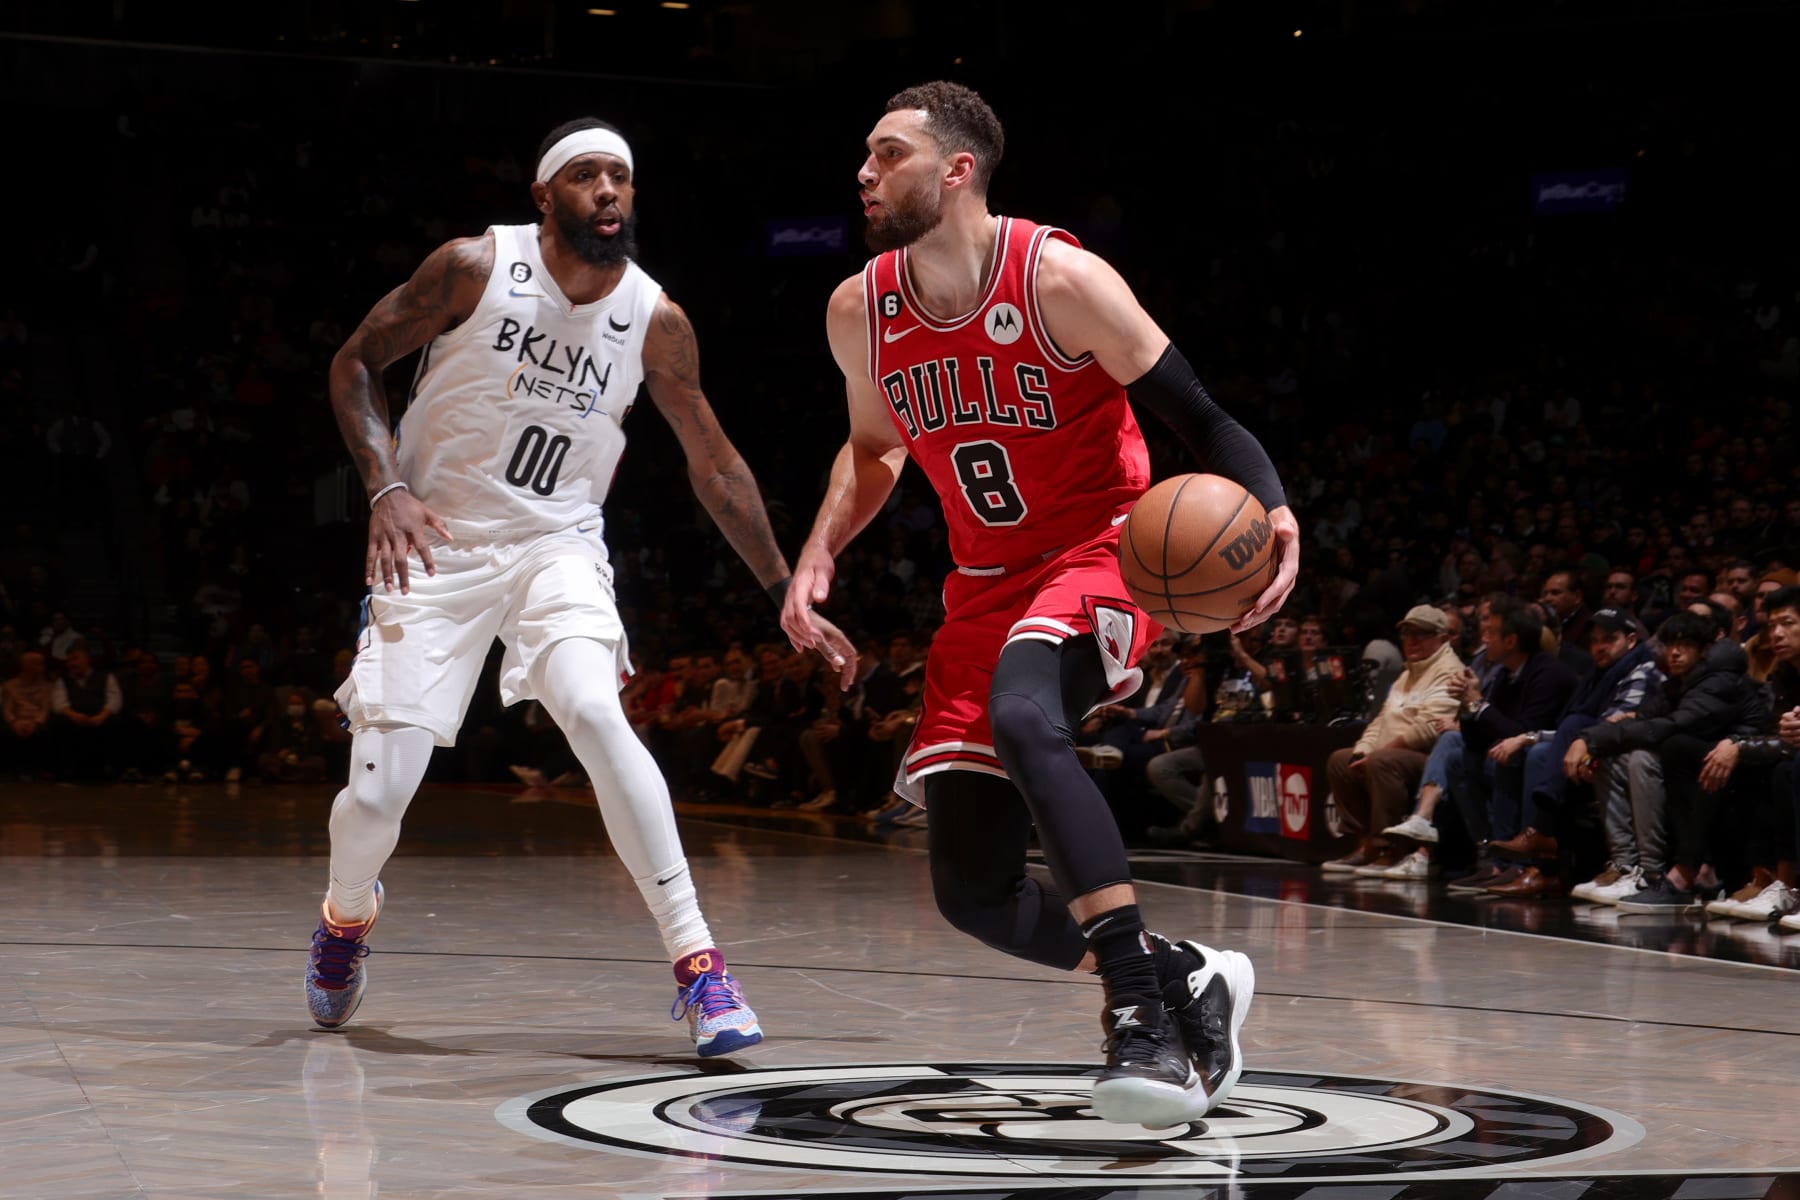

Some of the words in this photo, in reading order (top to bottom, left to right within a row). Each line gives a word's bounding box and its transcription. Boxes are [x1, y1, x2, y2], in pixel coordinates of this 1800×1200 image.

[512, 264, 529, 282] 6
[884, 294, 898, 317] 6
[492, 318, 612, 395] BKLYN
[514, 372, 592, 411] NETS
[881, 356, 1057, 440] BULLS
[505, 425, 571, 496] 00
[950, 439, 1028, 527] 8
